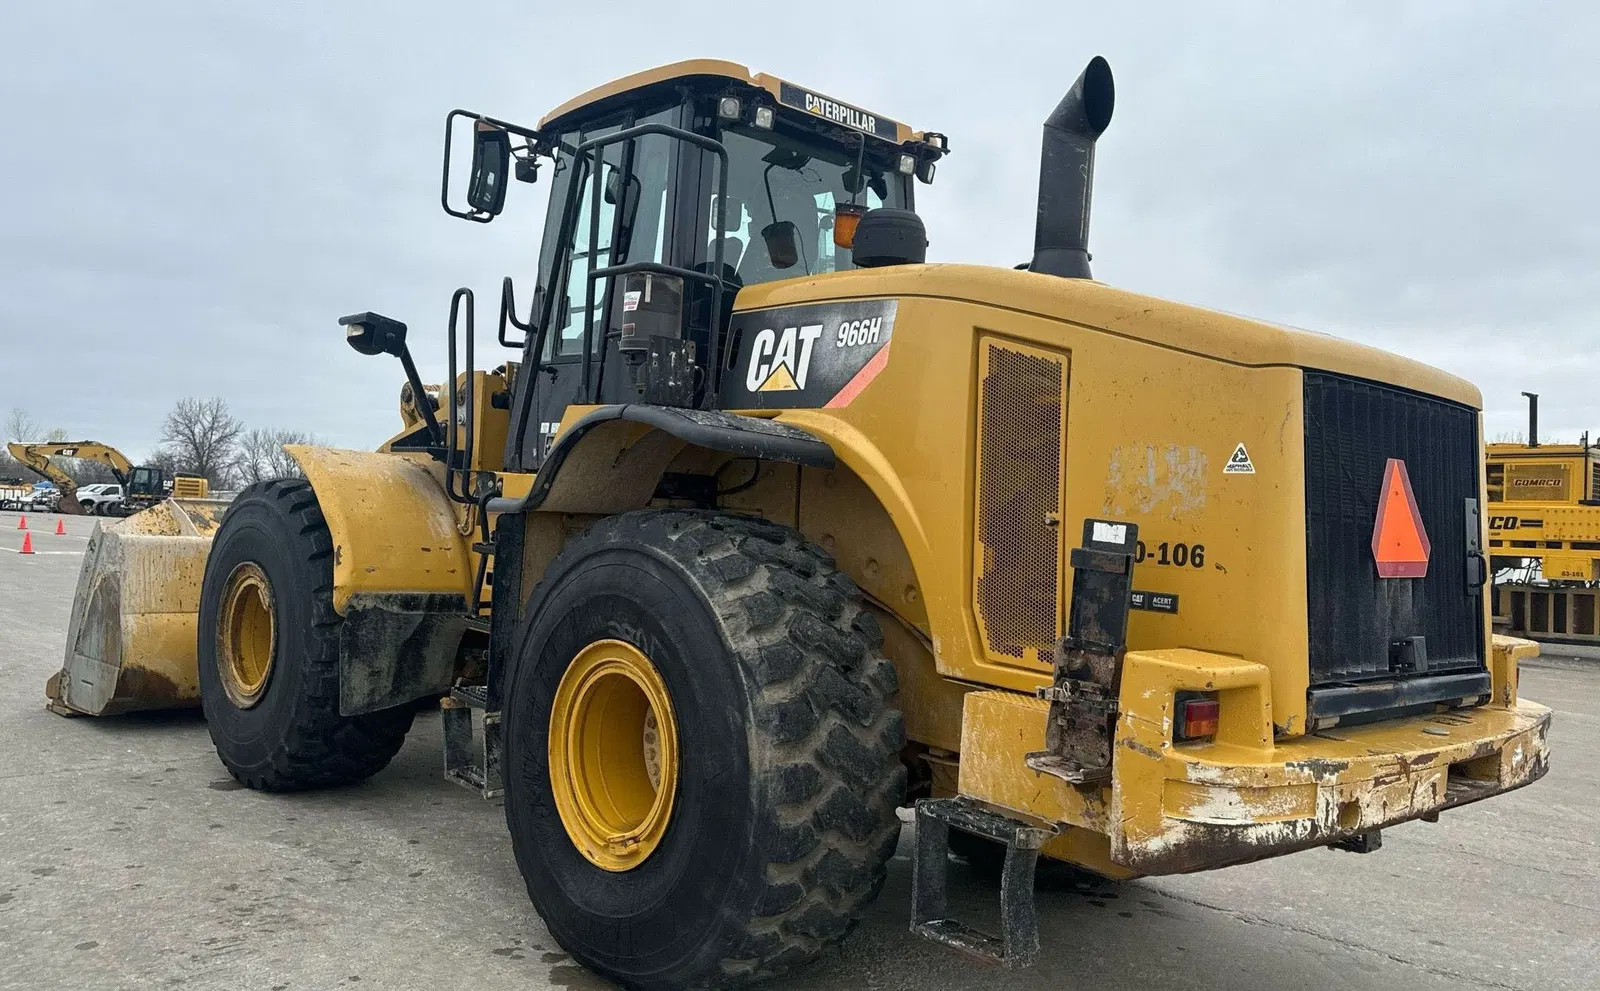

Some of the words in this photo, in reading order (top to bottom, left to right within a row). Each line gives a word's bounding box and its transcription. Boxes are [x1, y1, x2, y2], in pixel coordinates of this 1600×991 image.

[805, 93, 876, 134] CATERPILLAR
[836, 317, 882, 348] 966H
[746, 324, 823, 392] CAT
[1488, 516, 1518, 530] CO
[1132, 594, 1143, 603] CAT
[1152, 597, 1172, 605] ACERT
